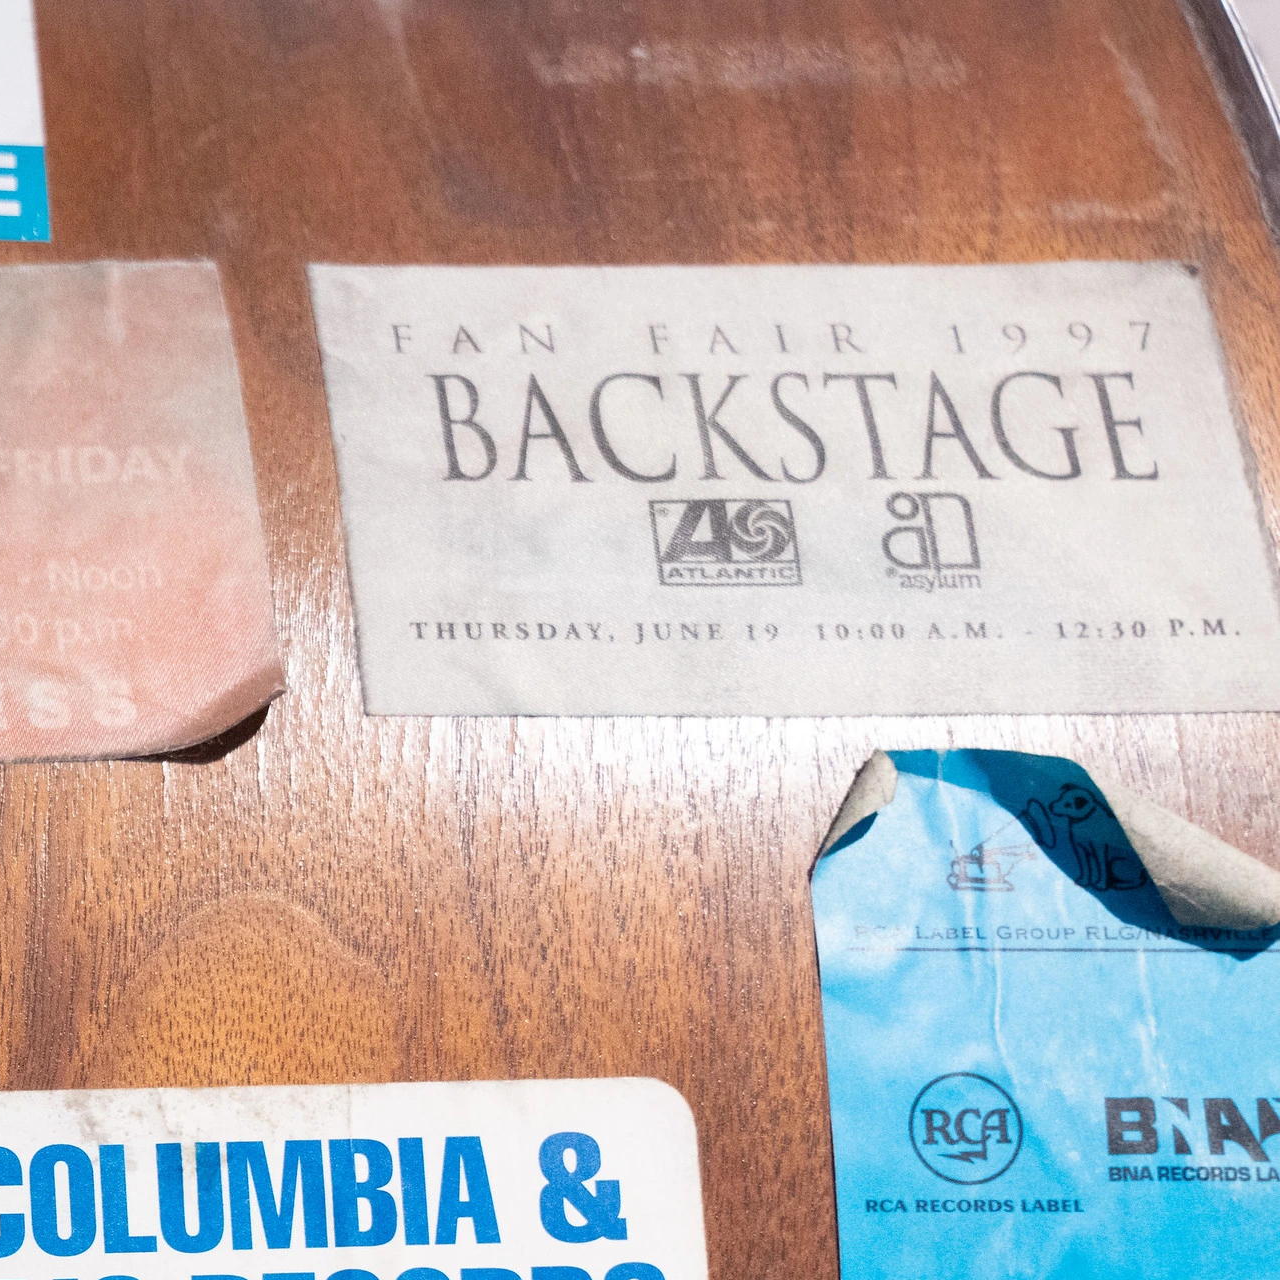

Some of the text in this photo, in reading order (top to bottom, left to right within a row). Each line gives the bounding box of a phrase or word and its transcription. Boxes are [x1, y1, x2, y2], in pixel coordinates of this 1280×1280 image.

[390, 320, 1155, 358] FAN FAIR 1997
[425, 369, 1160, 486] BACKSTAGE
[48, 559, 162, 592] Noon
[667, 566, 796, 581] ATLANTIC
[899, 569, 982, 594] asylum
[409, 621, 615, 643] THURSDAY,
[635, 621, 724, 645] JUNE
[745, 622, 779, 643] 19
[816, 622, 906, 641] 10:00
[927, 621, 1003, 641] A.M.
[1056, 620, 1147, 640] 12:30
[1168, 617, 1240, 638] P.M.
[921, 1108, 1012, 1148] RCA
[538, 1130, 628, 1245] &
[1108, 1166, 1154, 1182] BNA
[1157, 1166, 1251, 1182] RECORDS
[865, 1199, 1085, 1213] RCA RECORDS LABEL
